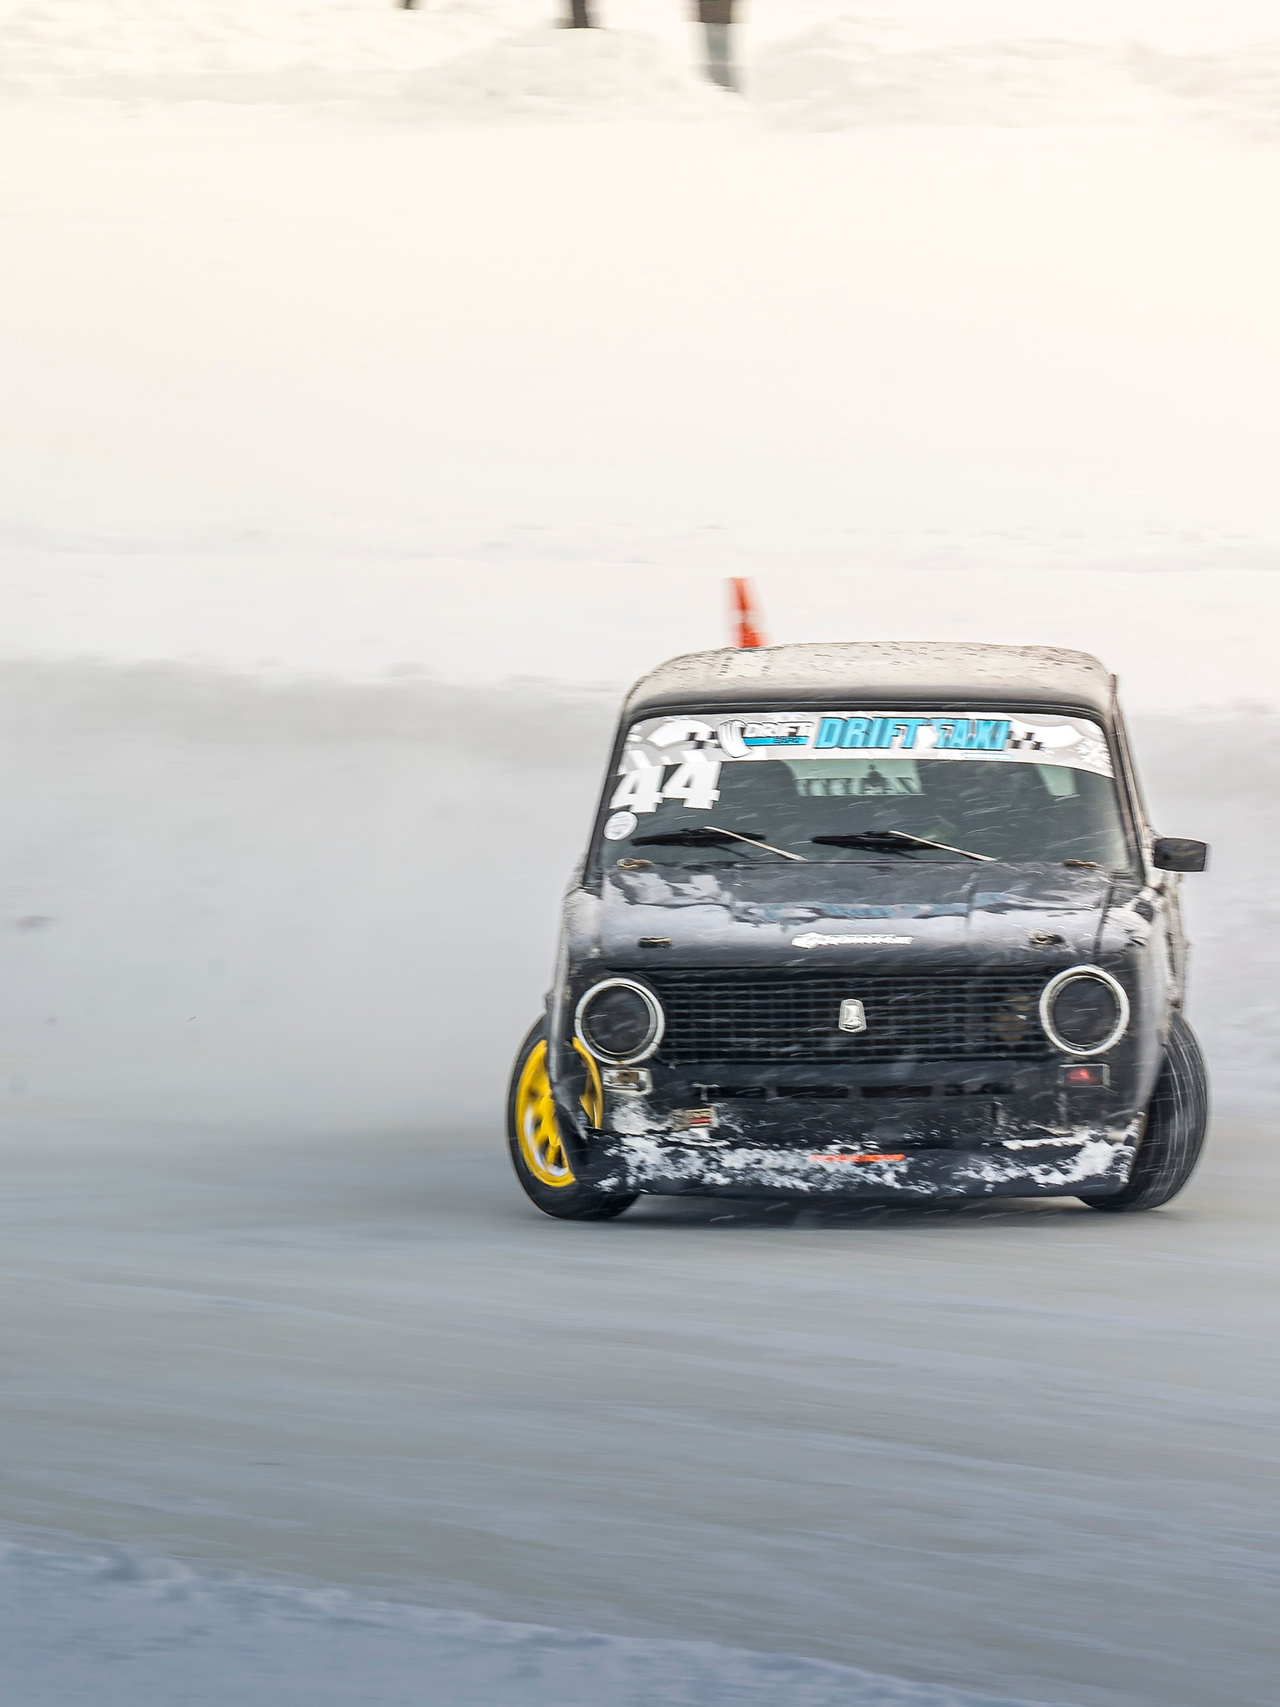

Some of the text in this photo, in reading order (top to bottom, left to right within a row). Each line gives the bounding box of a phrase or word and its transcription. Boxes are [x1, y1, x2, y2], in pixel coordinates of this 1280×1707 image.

[744, 721, 815, 738] DRIFT
[814, 716, 1013, 750] DRIFT TAXI
[609, 759, 722, 813] 44
